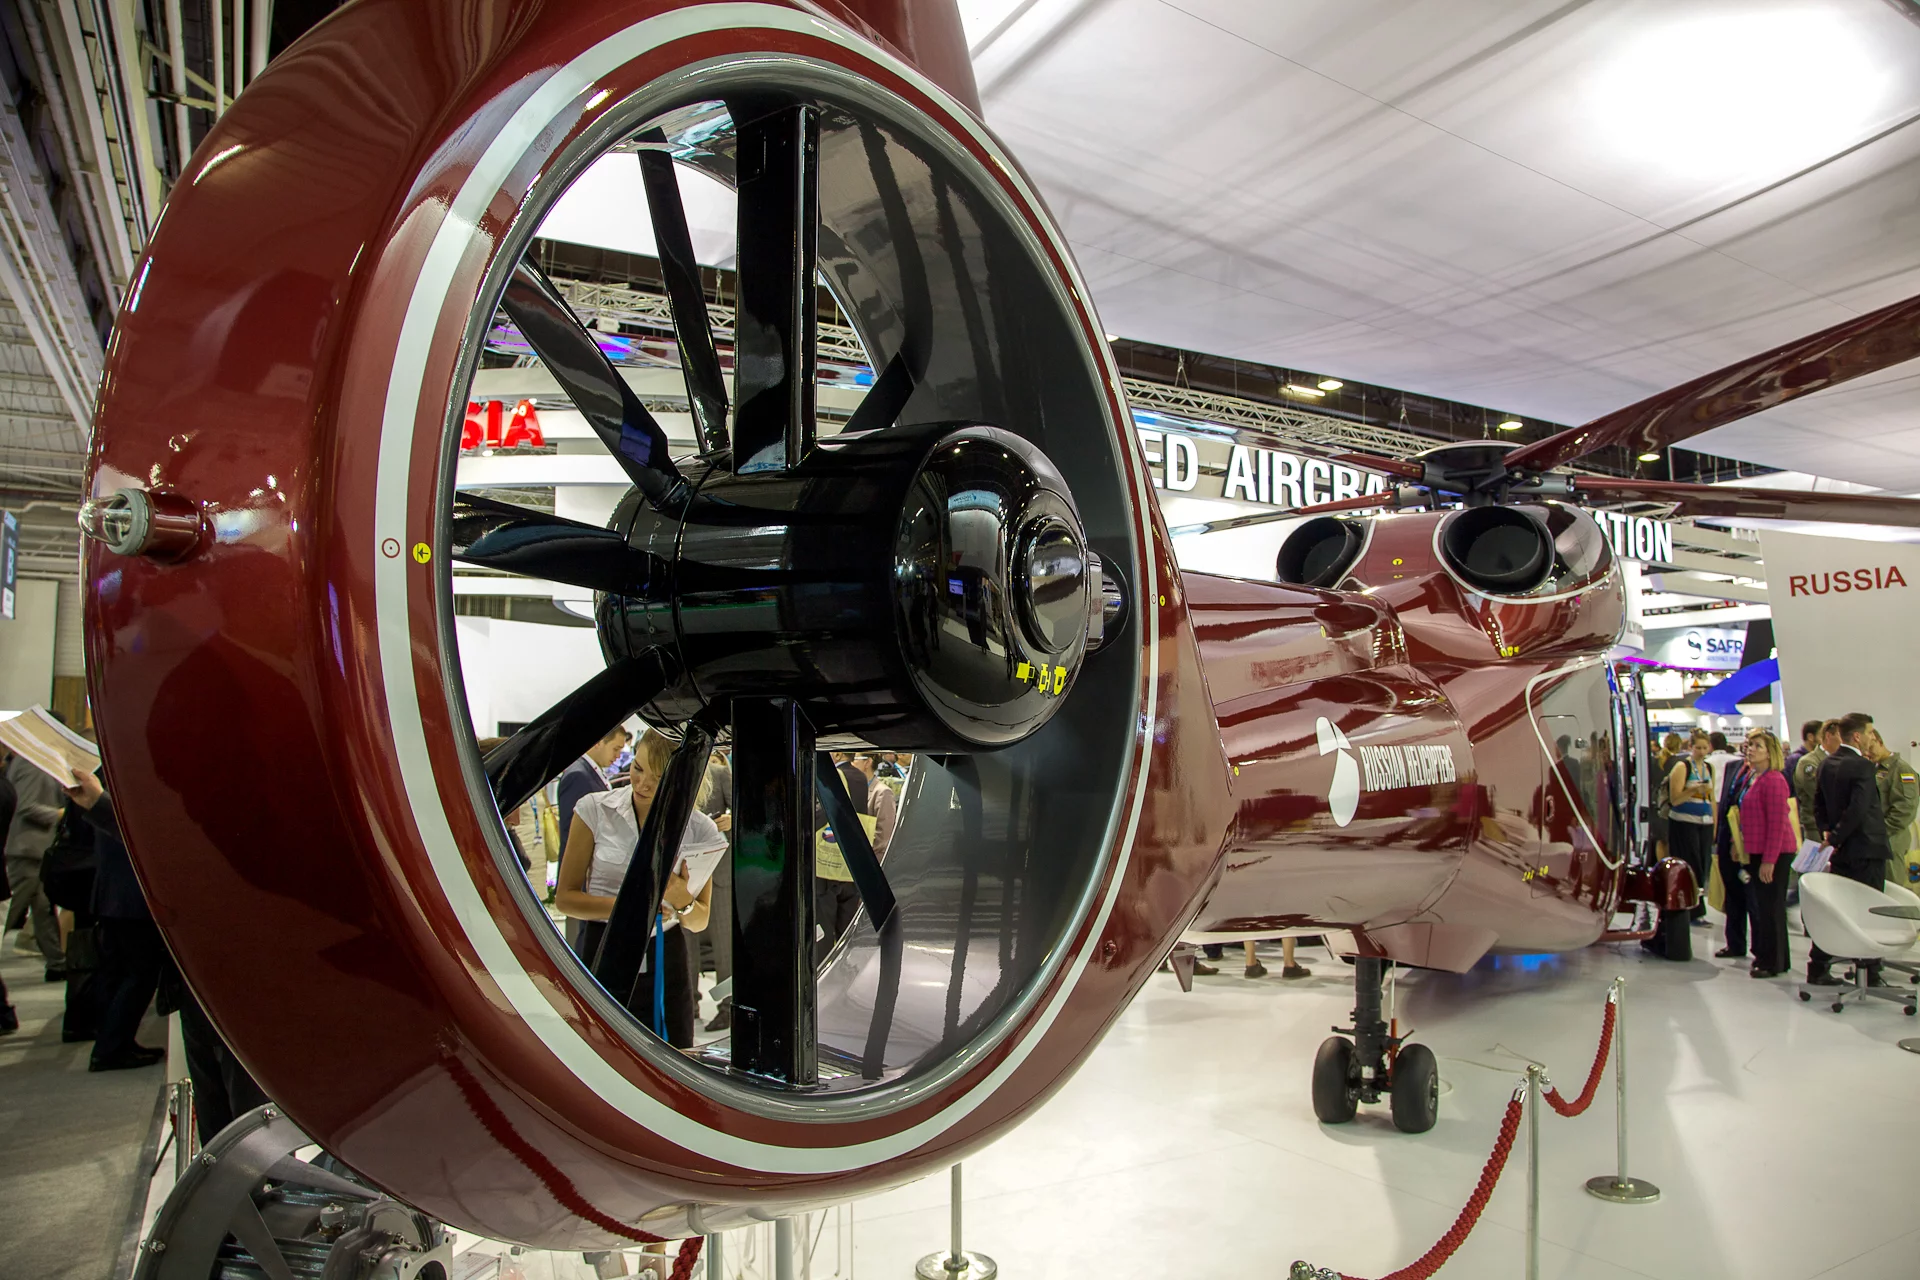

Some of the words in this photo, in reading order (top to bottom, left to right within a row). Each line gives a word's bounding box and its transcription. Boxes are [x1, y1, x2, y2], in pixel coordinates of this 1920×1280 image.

[1789, 566, 1907, 597] RUSSIA
[1359, 746, 1407, 792] RUSSIAN
[1403, 745, 1457, 787] HELICOPTERS
